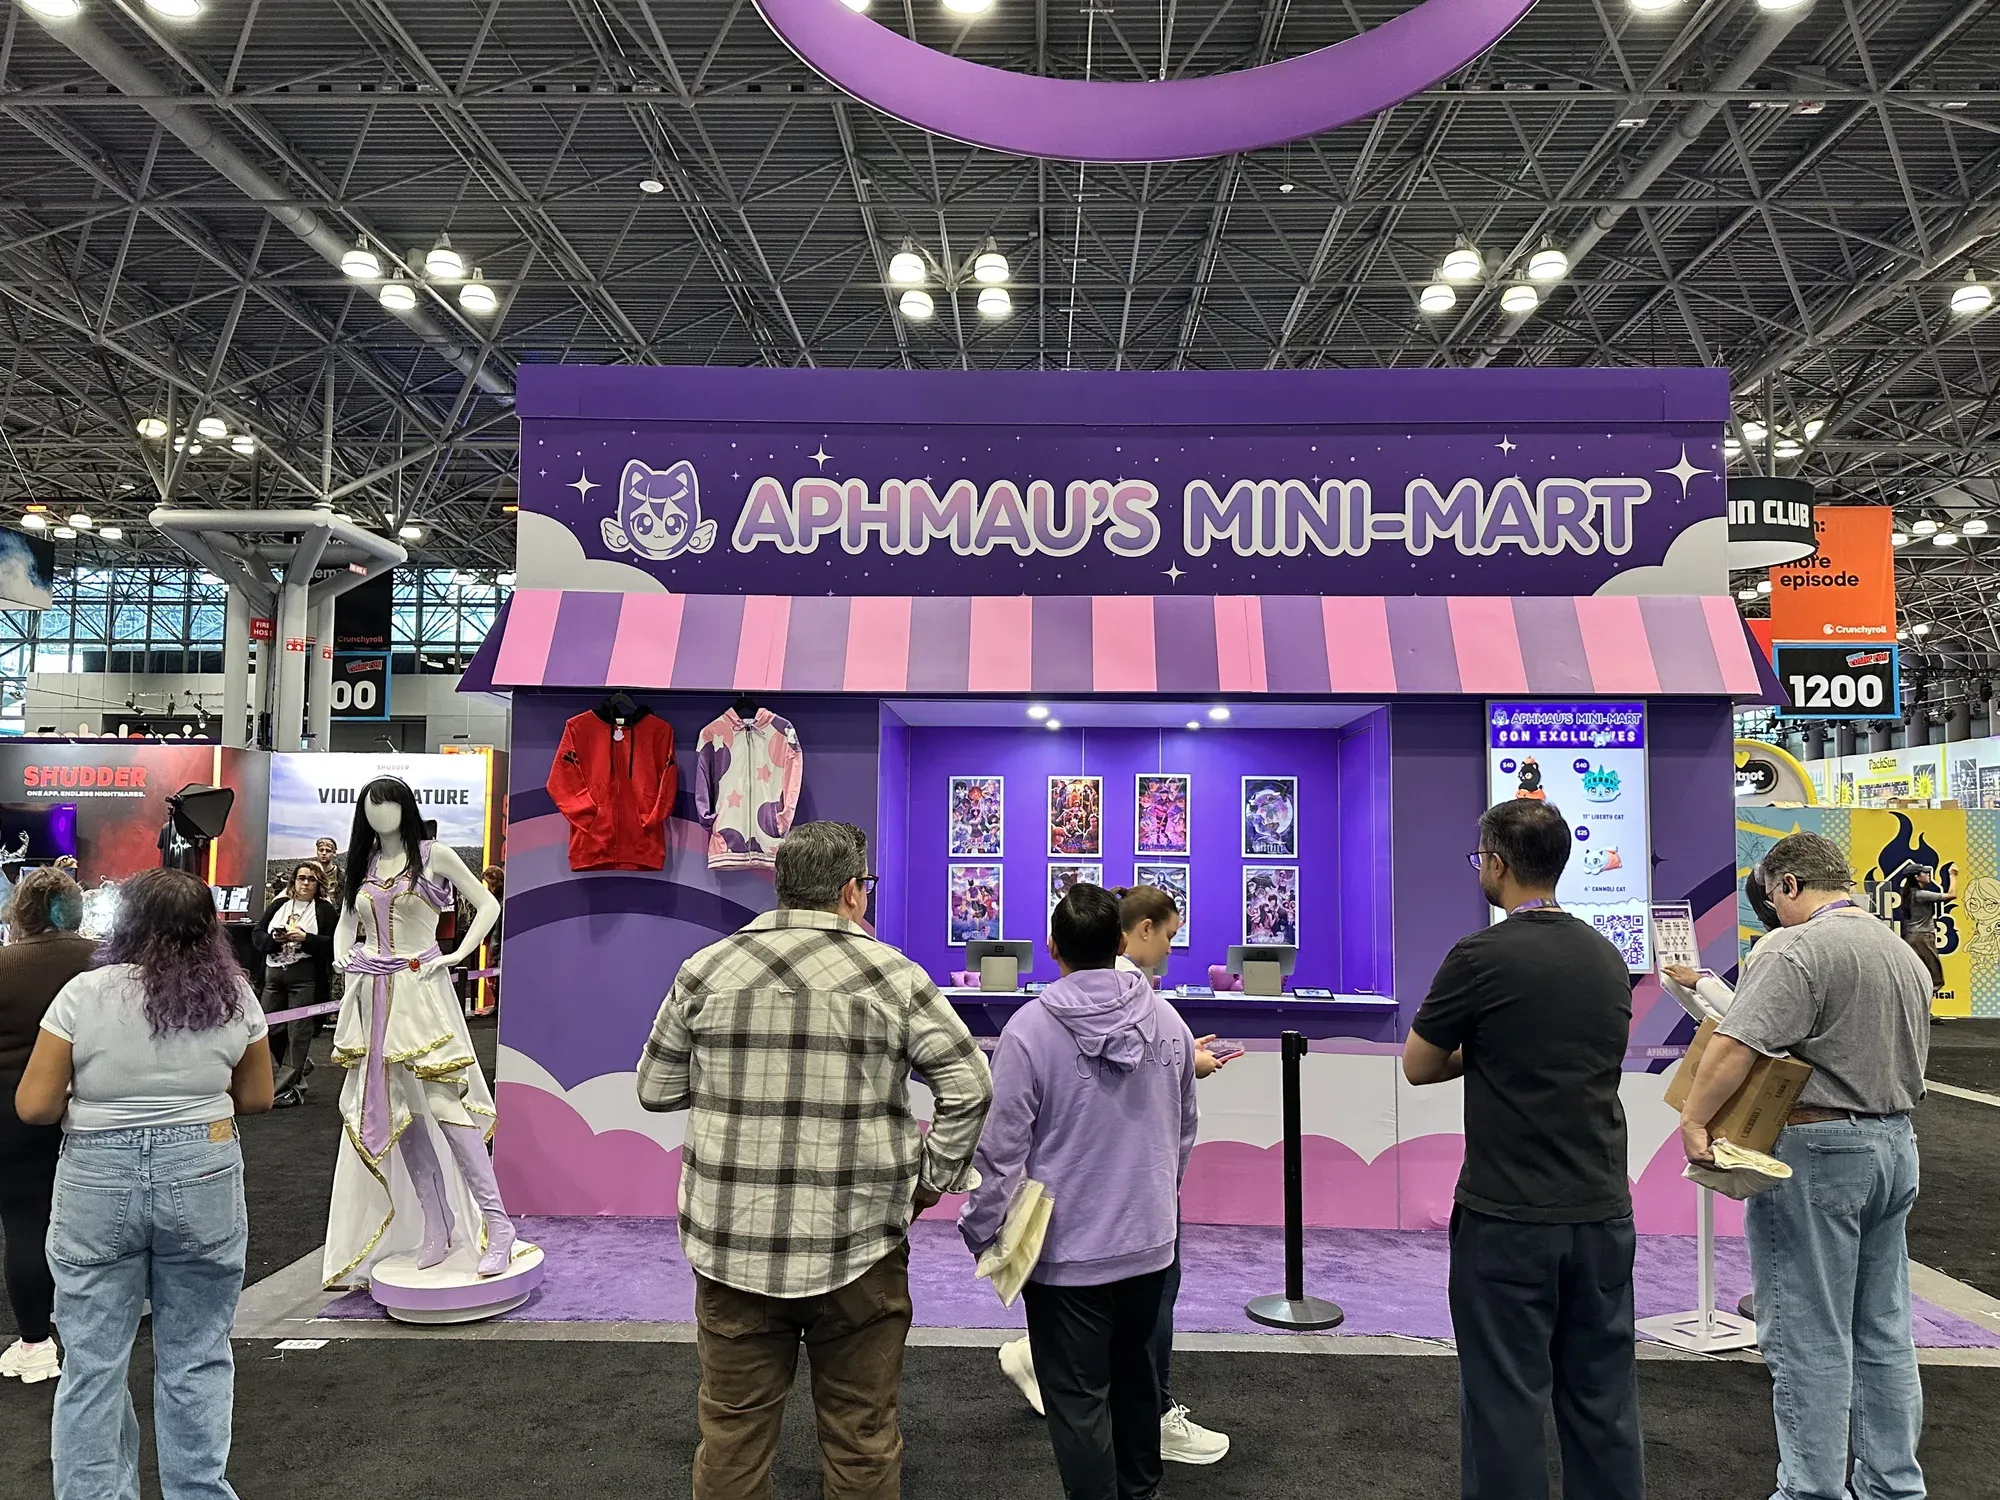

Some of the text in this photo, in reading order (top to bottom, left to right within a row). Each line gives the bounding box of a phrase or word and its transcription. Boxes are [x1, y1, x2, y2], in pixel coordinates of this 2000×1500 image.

[731, 477, 1652, 557] APHMAU'S MINI-MART
[1763, 500, 1810, 528] CLUB
[1780, 570, 1860, 591] episode
[256, 621, 270, 629] FIRE
[1836, 625, 1887, 635] Crunchyroll
[337, 635, 383, 644] Crunchyroll
[1789, 674, 1883, 708] 1200
[1511, 713, 1642, 725] APHMAU'S MINI-MART
[1499, 730, 1636, 742] CON EXCLUES
[23, 765, 148, 788] SHUDDER
[60, 790, 94, 798] ENDLESS
[414, 788, 469, 805] ATURE
